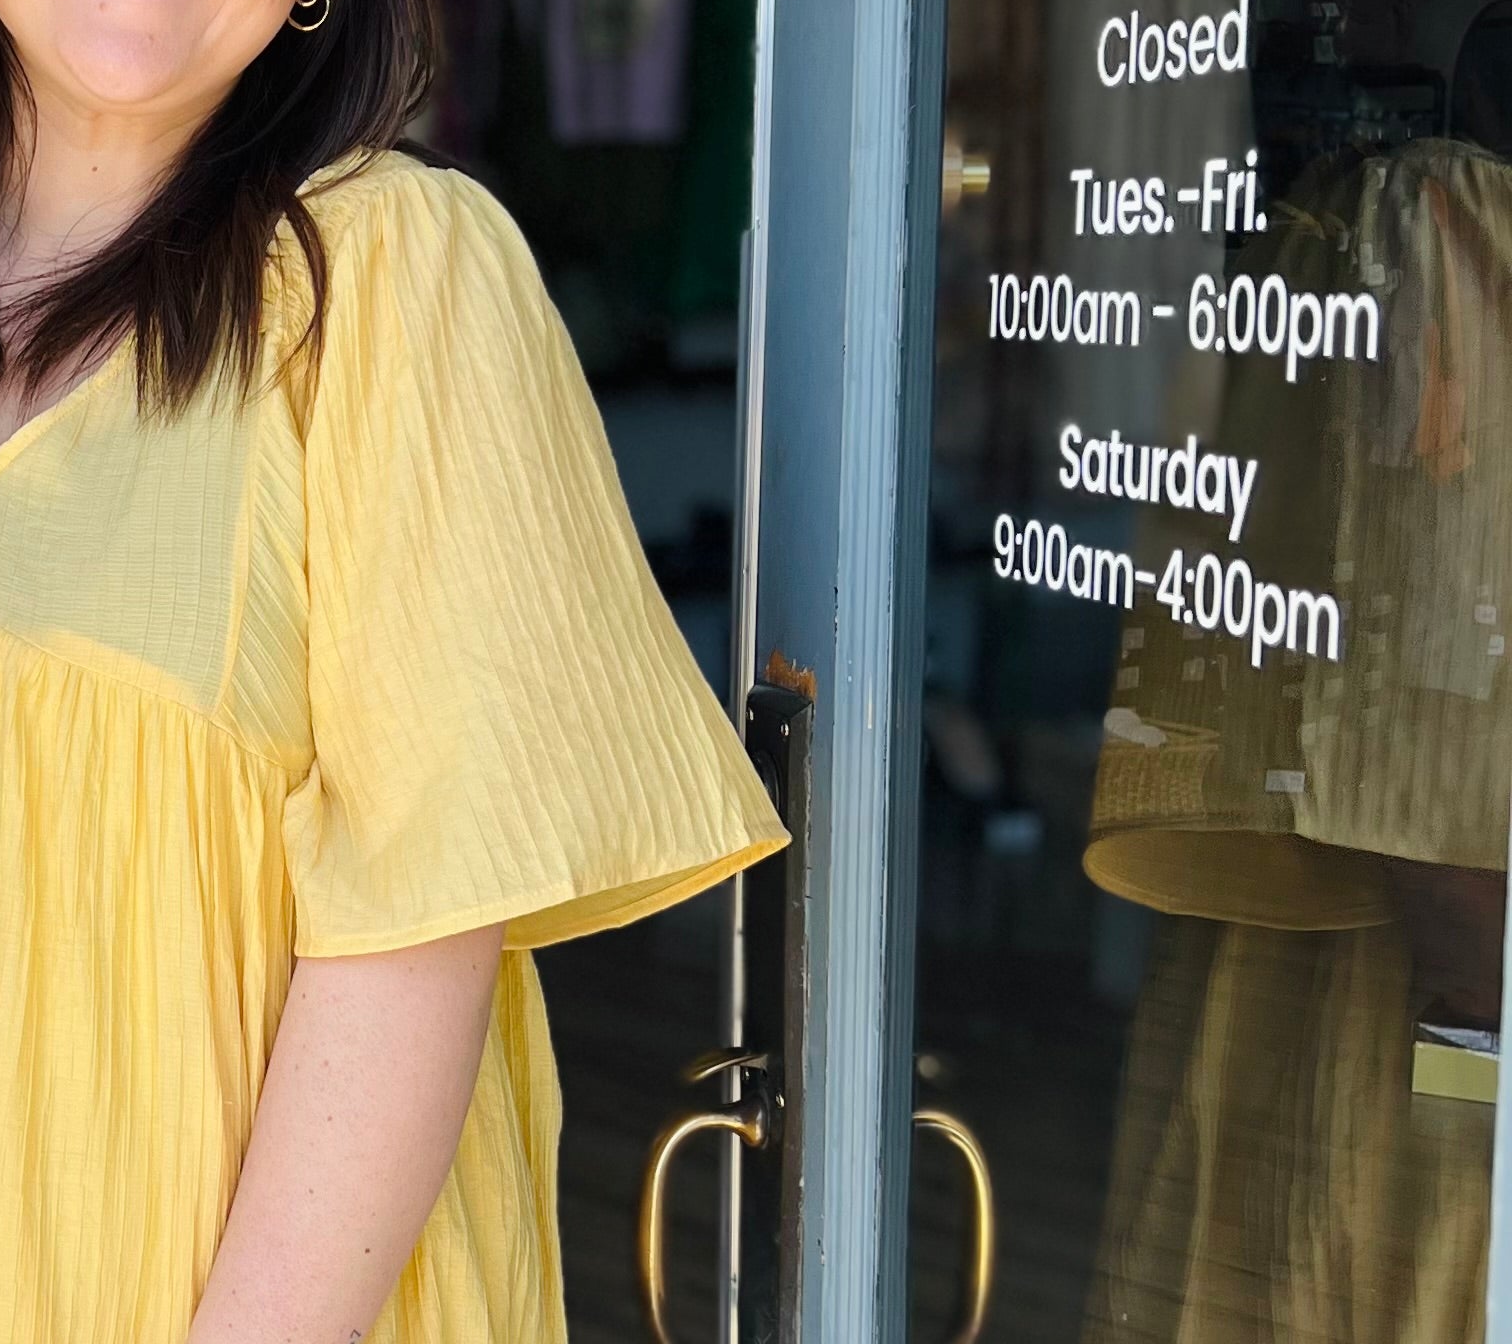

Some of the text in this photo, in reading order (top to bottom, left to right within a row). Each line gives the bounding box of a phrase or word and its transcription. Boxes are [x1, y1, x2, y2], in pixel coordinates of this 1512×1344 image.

[988, 273, 1141, 347] 10:00am
[1188, 273, 1379, 382] 6:00pm
[1059, 423, 1258, 542] Saturday
